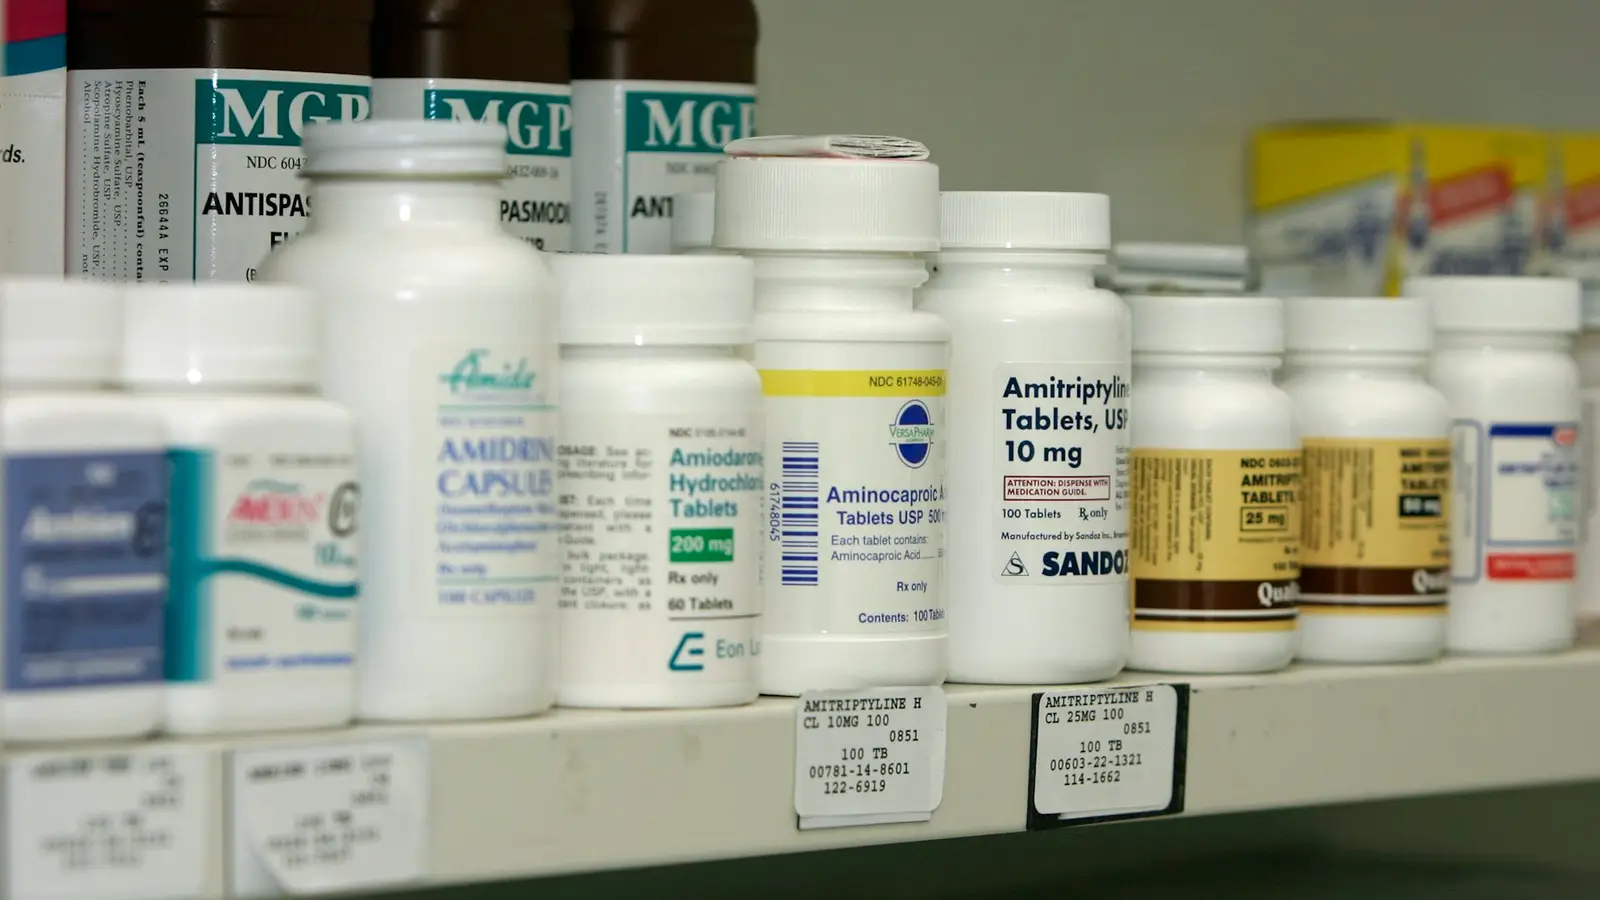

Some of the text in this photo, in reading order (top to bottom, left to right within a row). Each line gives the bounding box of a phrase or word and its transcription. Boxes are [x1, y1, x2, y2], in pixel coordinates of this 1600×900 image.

[83, 80, 91, 124] Alcohol
[138, 80, 147, 110] Each
[92, 80, 101, 152] Scopolamine
[214, 87, 370, 139] MGP
[103, 80, 112, 200] Atropine Sulfate, USP
[124, 80, 134, 188] Phenobarbital, USP
[137, 127, 146, 148] mL
[113, 80, 123, 226] Hyoscyamine Sulfate, USP
[246, 155, 277, 169] NDC
[92, 156, 101, 240] Hydrobromide,
[136, 152, 145, 238] (teaspoonful)
[158, 193, 169, 272] 26644A EXP
[868, 376, 894, 387] NDC
[1002, 407, 1099, 433] Tablets,
[1005, 440, 1083, 469] 10 mg
[1007, 479, 1109, 488] ATTENTION: DISPENSE WITH
[826, 485, 938, 507] Aminocaproic
[1007, 488, 1087, 497] MEDICATION GUIDE.
[668, 497, 739, 518] Tablets
[769, 482, 780, 542] 61748045
[1002, 508, 1022, 519] 100
[1025, 508, 1062, 519] Tablets
[1090, 507, 1109, 520] only
[836, 510, 894, 526] Tablets
[898, 509, 924, 525] USP
[928, 508, 941, 524] 500
[1246, 511, 1285, 527] 25 mg
[671, 535, 733, 556] 200 mg
[830, 533, 929, 546] Each tablet contains:
[1001, 531, 1063, 541] Manufactured
[1063, 531, 1074, 544] by
[1075, 531, 1101, 541] Sandoz
[830, 549, 921, 563] Aminocaproic Acid
[667, 570, 719, 587] Rx only
[896, 580, 928, 593] Rx only
[667, 596, 734, 611] 60 Tablets
[858, 612, 909, 624] Contents:
[914, 610, 928, 622] 100
[715, 638, 745, 659] Eon
[803, 697, 922, 713] AMITRIPTYLINE H
[1045, 690, 1154, 709] AMITRIPTYLINE H
[803, 714, 890, 729] CL 10MG 100
[1045, 708, 1125, 724] CL 25MG 100
[889, 729, 919, 742] 0851
[1123, 721, 1151, 735] 0851
[841, 747, 889, 761] 100 TB
[1080, 739, 1123, 753] 100 TB
[809, 762, 910, 779] 00781-14-8601
[1050, 753, 1143, 772] 00603-22-1321
[1063, 770, 1121, 786] 114-1662
[824, 779, 887, 795] 122-6919
